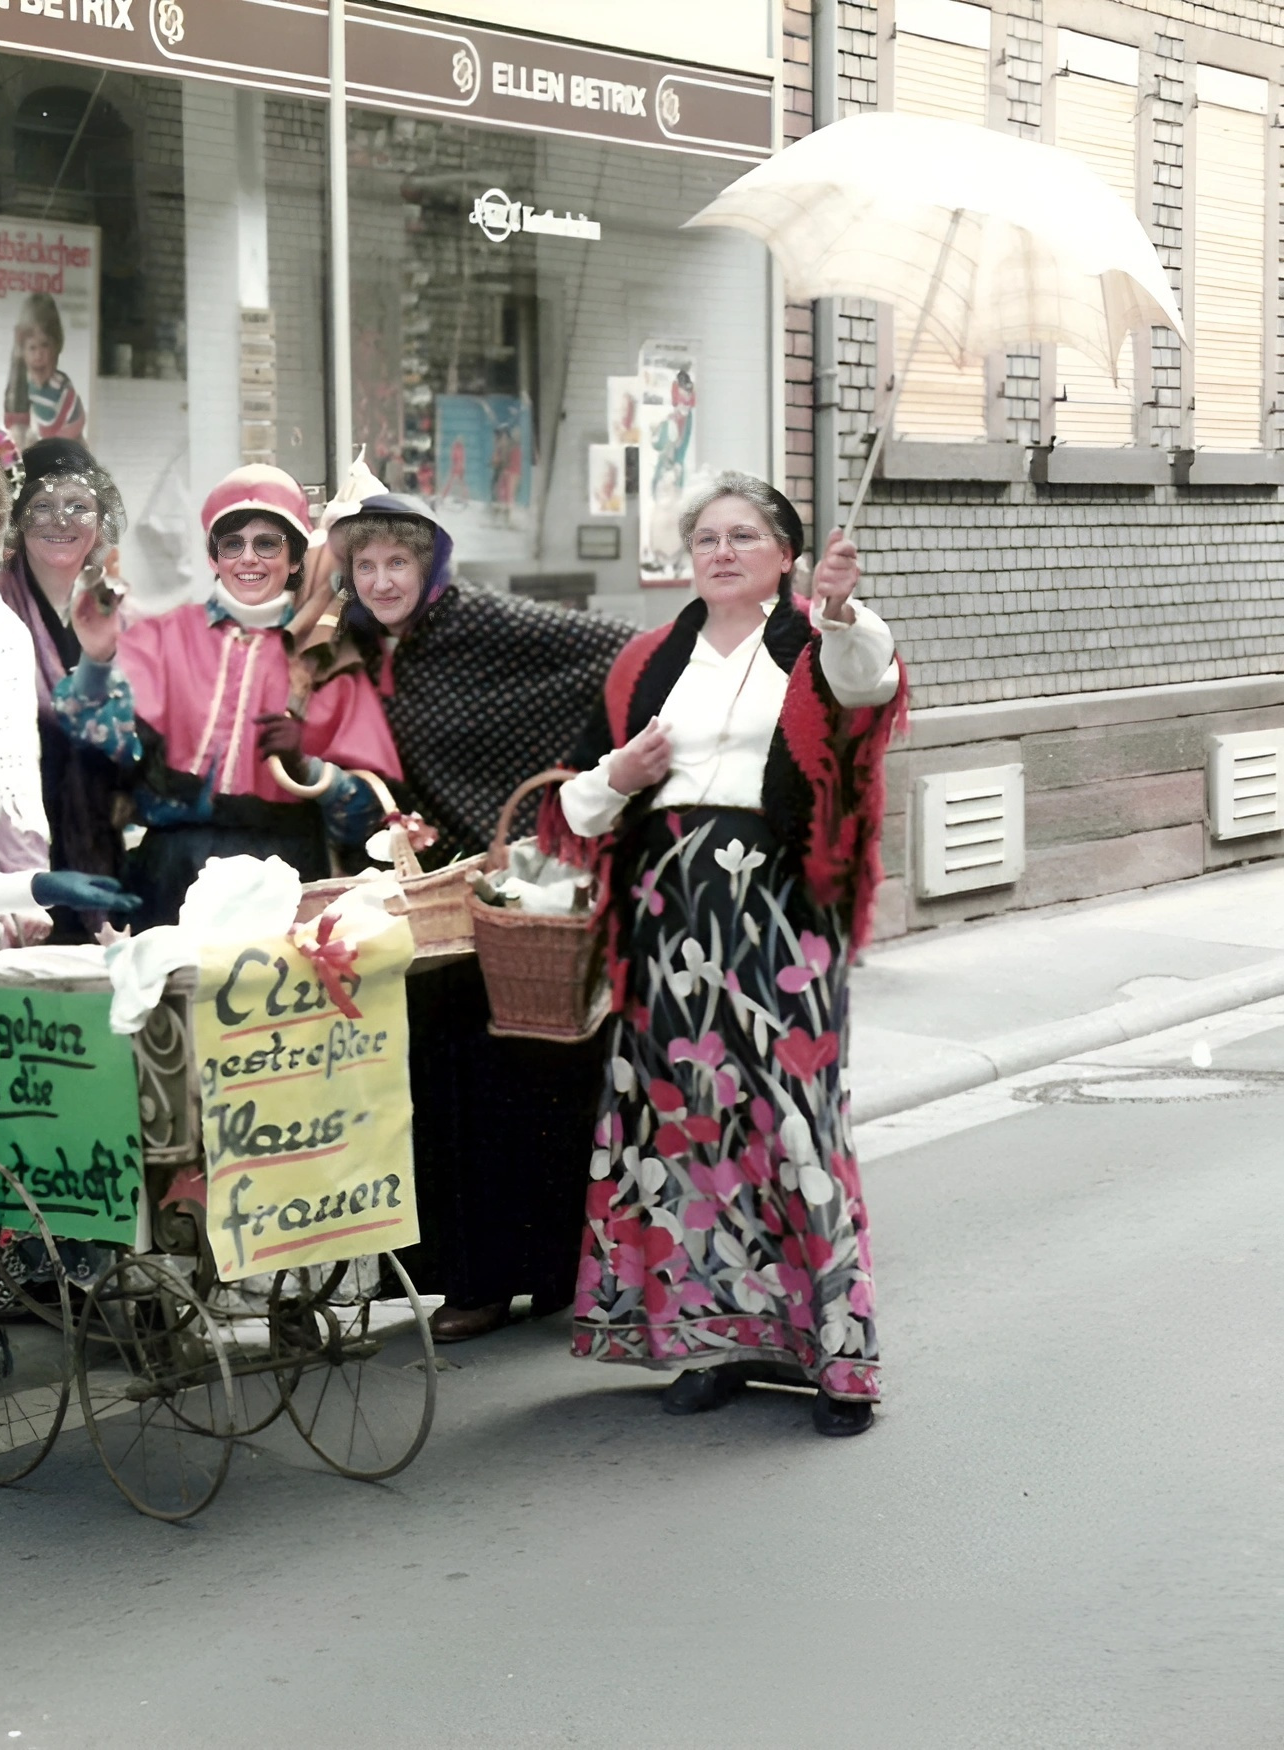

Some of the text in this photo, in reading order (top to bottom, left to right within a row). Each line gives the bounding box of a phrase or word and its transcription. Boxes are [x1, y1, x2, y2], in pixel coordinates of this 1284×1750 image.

[492, 61, 647, 117] ELLEN BETRIX
[10, 1063, 54, 1106] die
[202, 1021, 387, 1096] gestreßter
[222, 1173, 401, 1268] frauen
